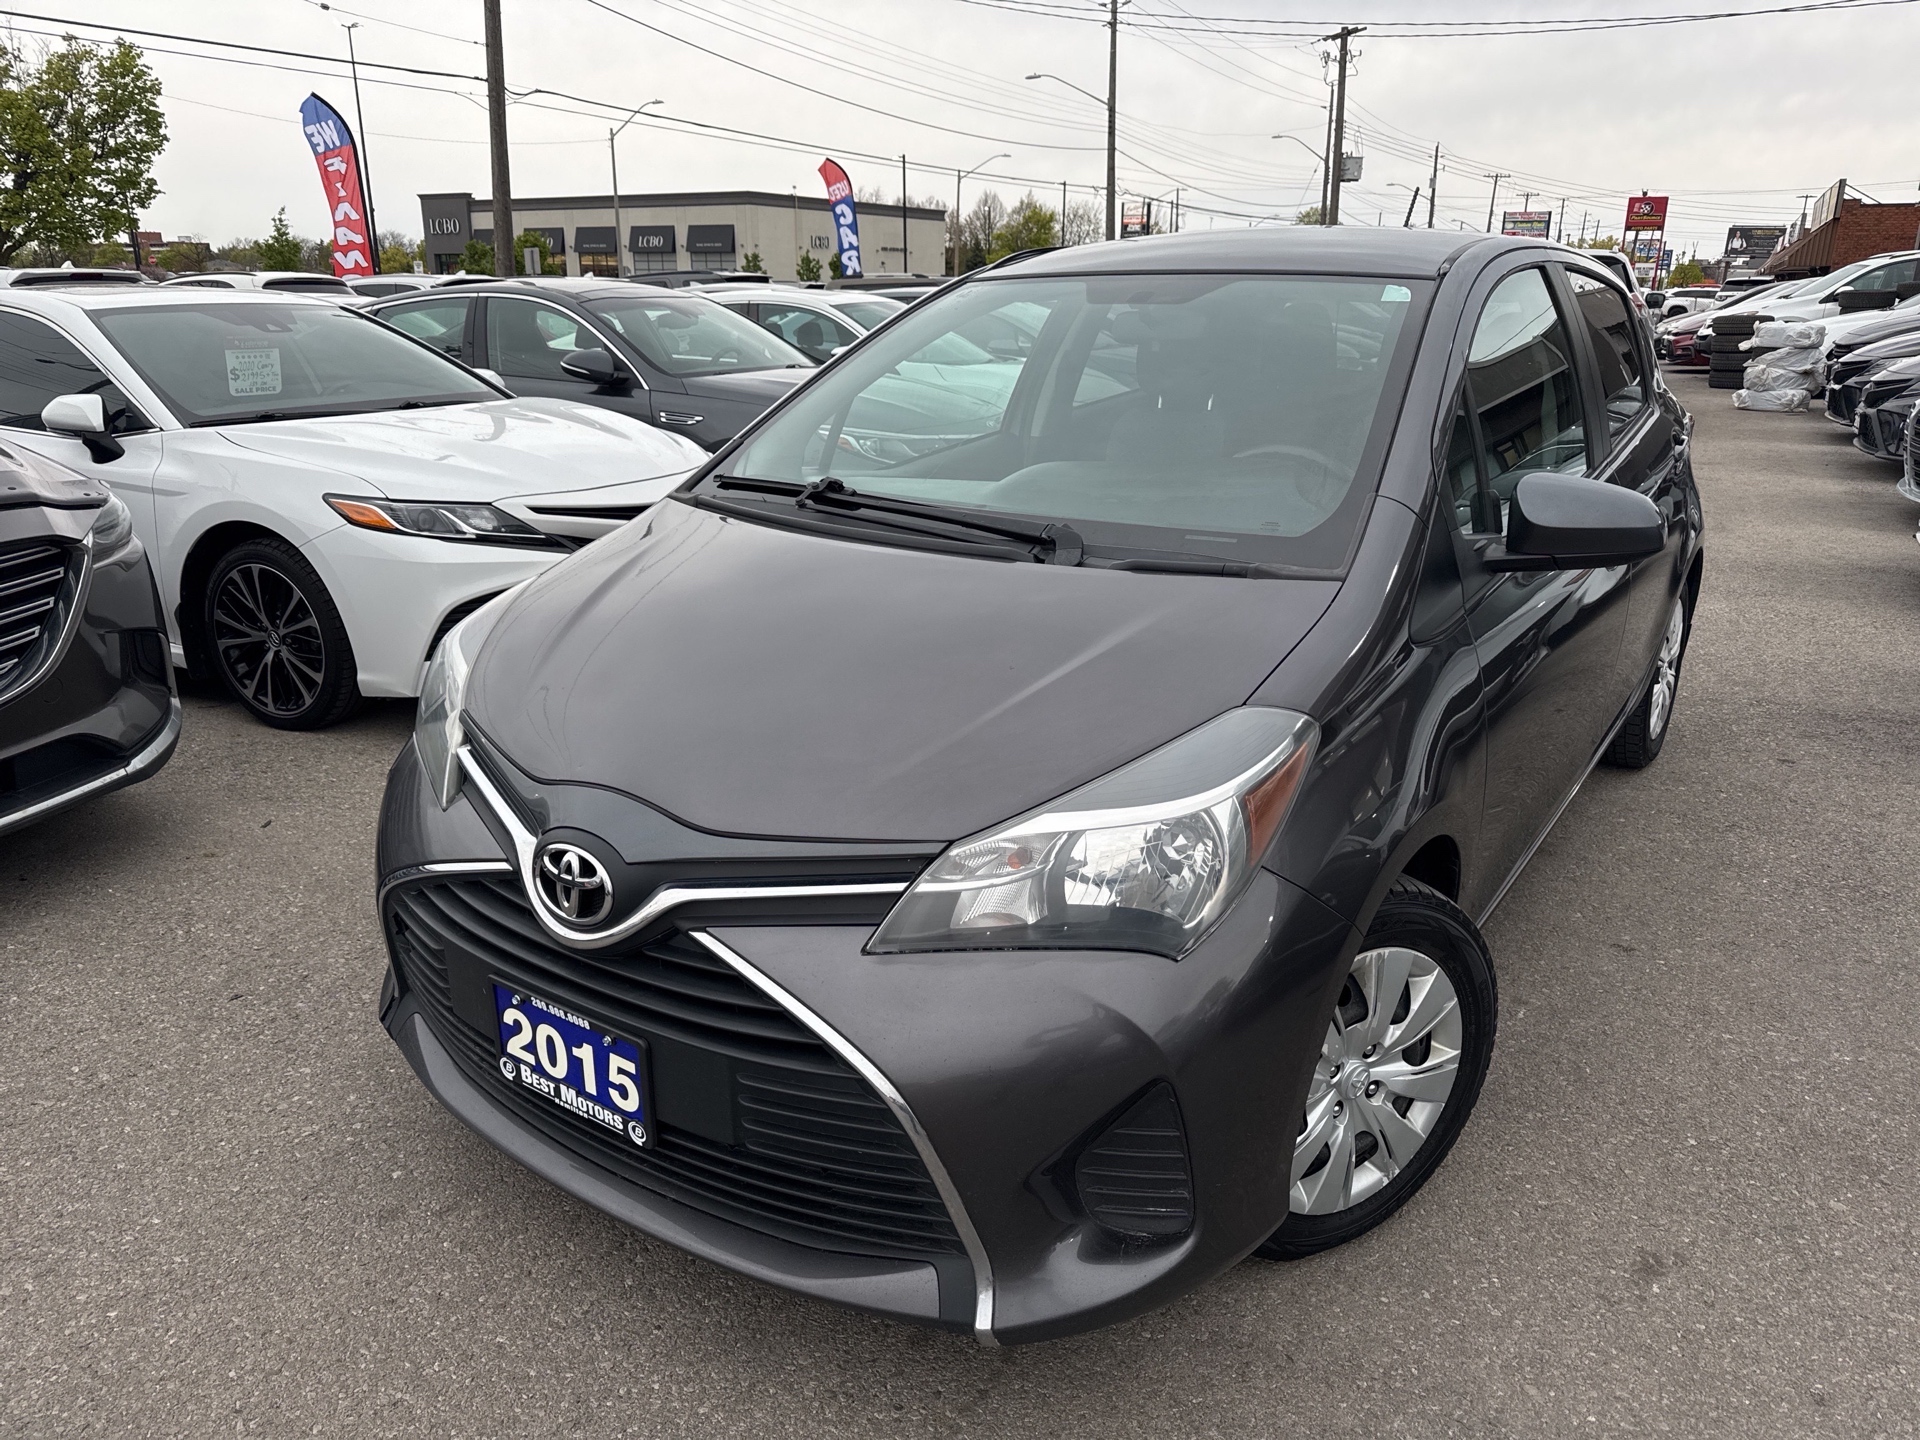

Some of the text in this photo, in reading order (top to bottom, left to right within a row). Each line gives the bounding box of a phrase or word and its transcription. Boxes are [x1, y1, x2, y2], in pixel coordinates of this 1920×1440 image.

[429, 217, 460, 235] LCBO
[638, 235, 664, 248] LCBO
[810, 235, 830, 249] LCBO
[503, 1008, 640, 1113] 2015
[519, 1063, 624, 1130] BEST MOTORS
[554, 1097, 589, 1119] Hamilton
